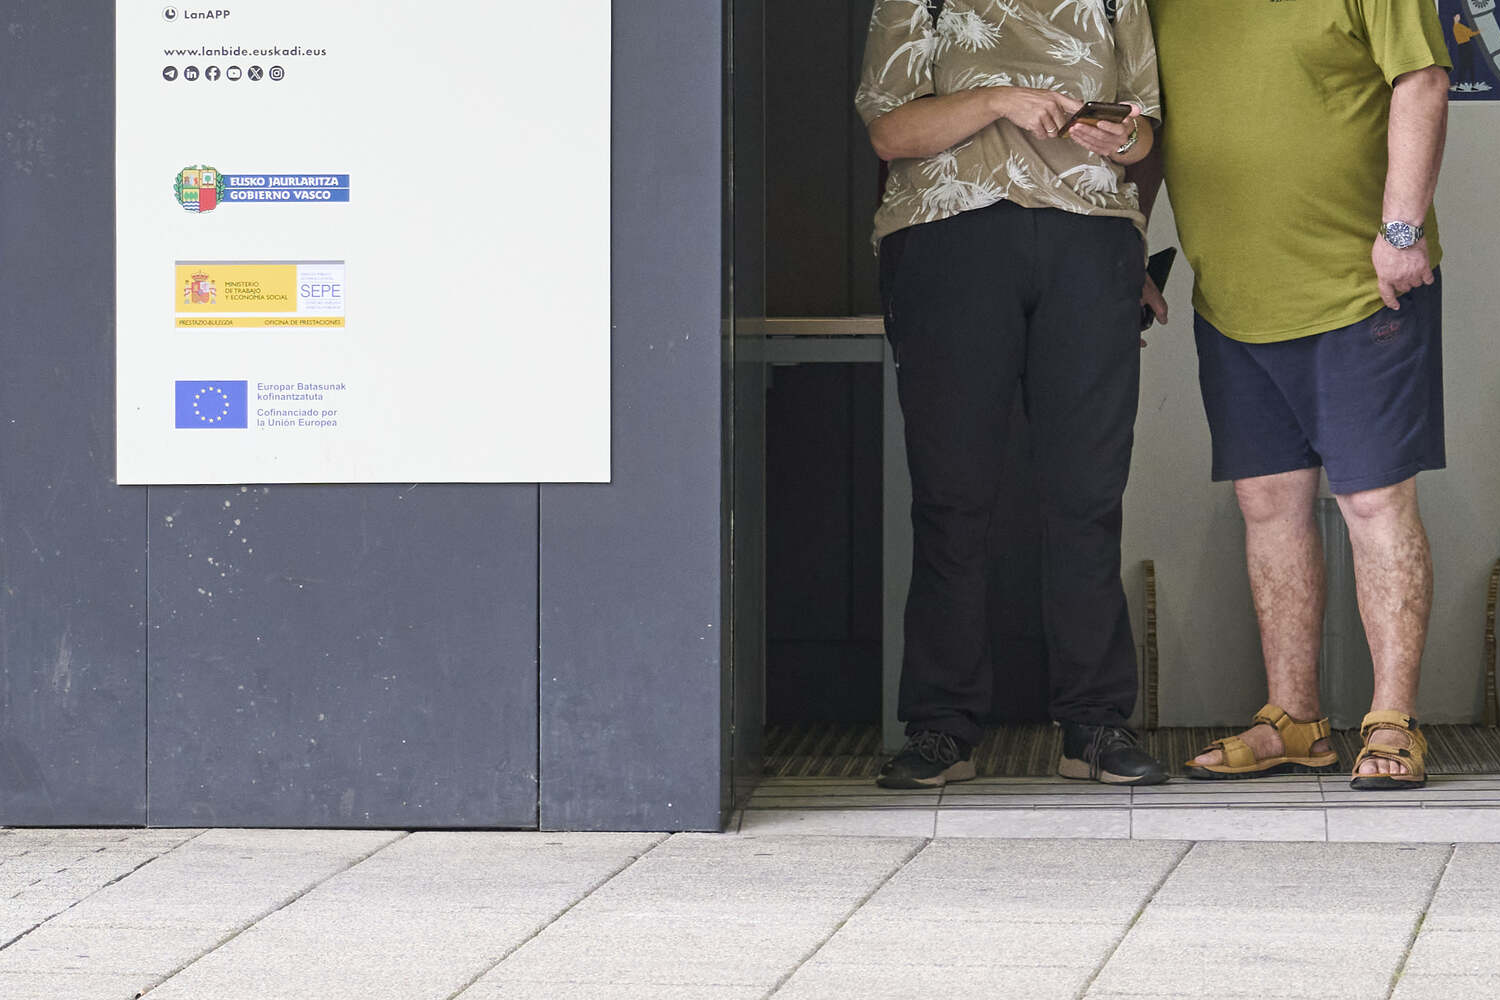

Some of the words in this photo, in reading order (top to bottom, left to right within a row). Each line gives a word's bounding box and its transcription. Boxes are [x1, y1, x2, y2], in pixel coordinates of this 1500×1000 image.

[184, 10, 231, 19] LanAPP
[163, 46, 327, 56] www.lanbide.euskadi.eus
[230, 177, 265, 186] EUSKO
[268, 177, 339, 187] JAURLARITZA
[230, 191, 290, 200] GOBIERNO
[292, 191, 331, 200] VASCO
[300, 284, 341, 298] SEPE
[257, 383, 294, 392] Europar
[297, 382, 346, 391] Batasunak
[257, 392, 323, 401] kofinantzatuta
[257, 408, 319, 417] Cofinanciado
[321, 410, 337, 418] por
[257, 419, 265, 427] la
[268, 418, 295, 427] Unión
[298, 419, 337, 428] Europea
